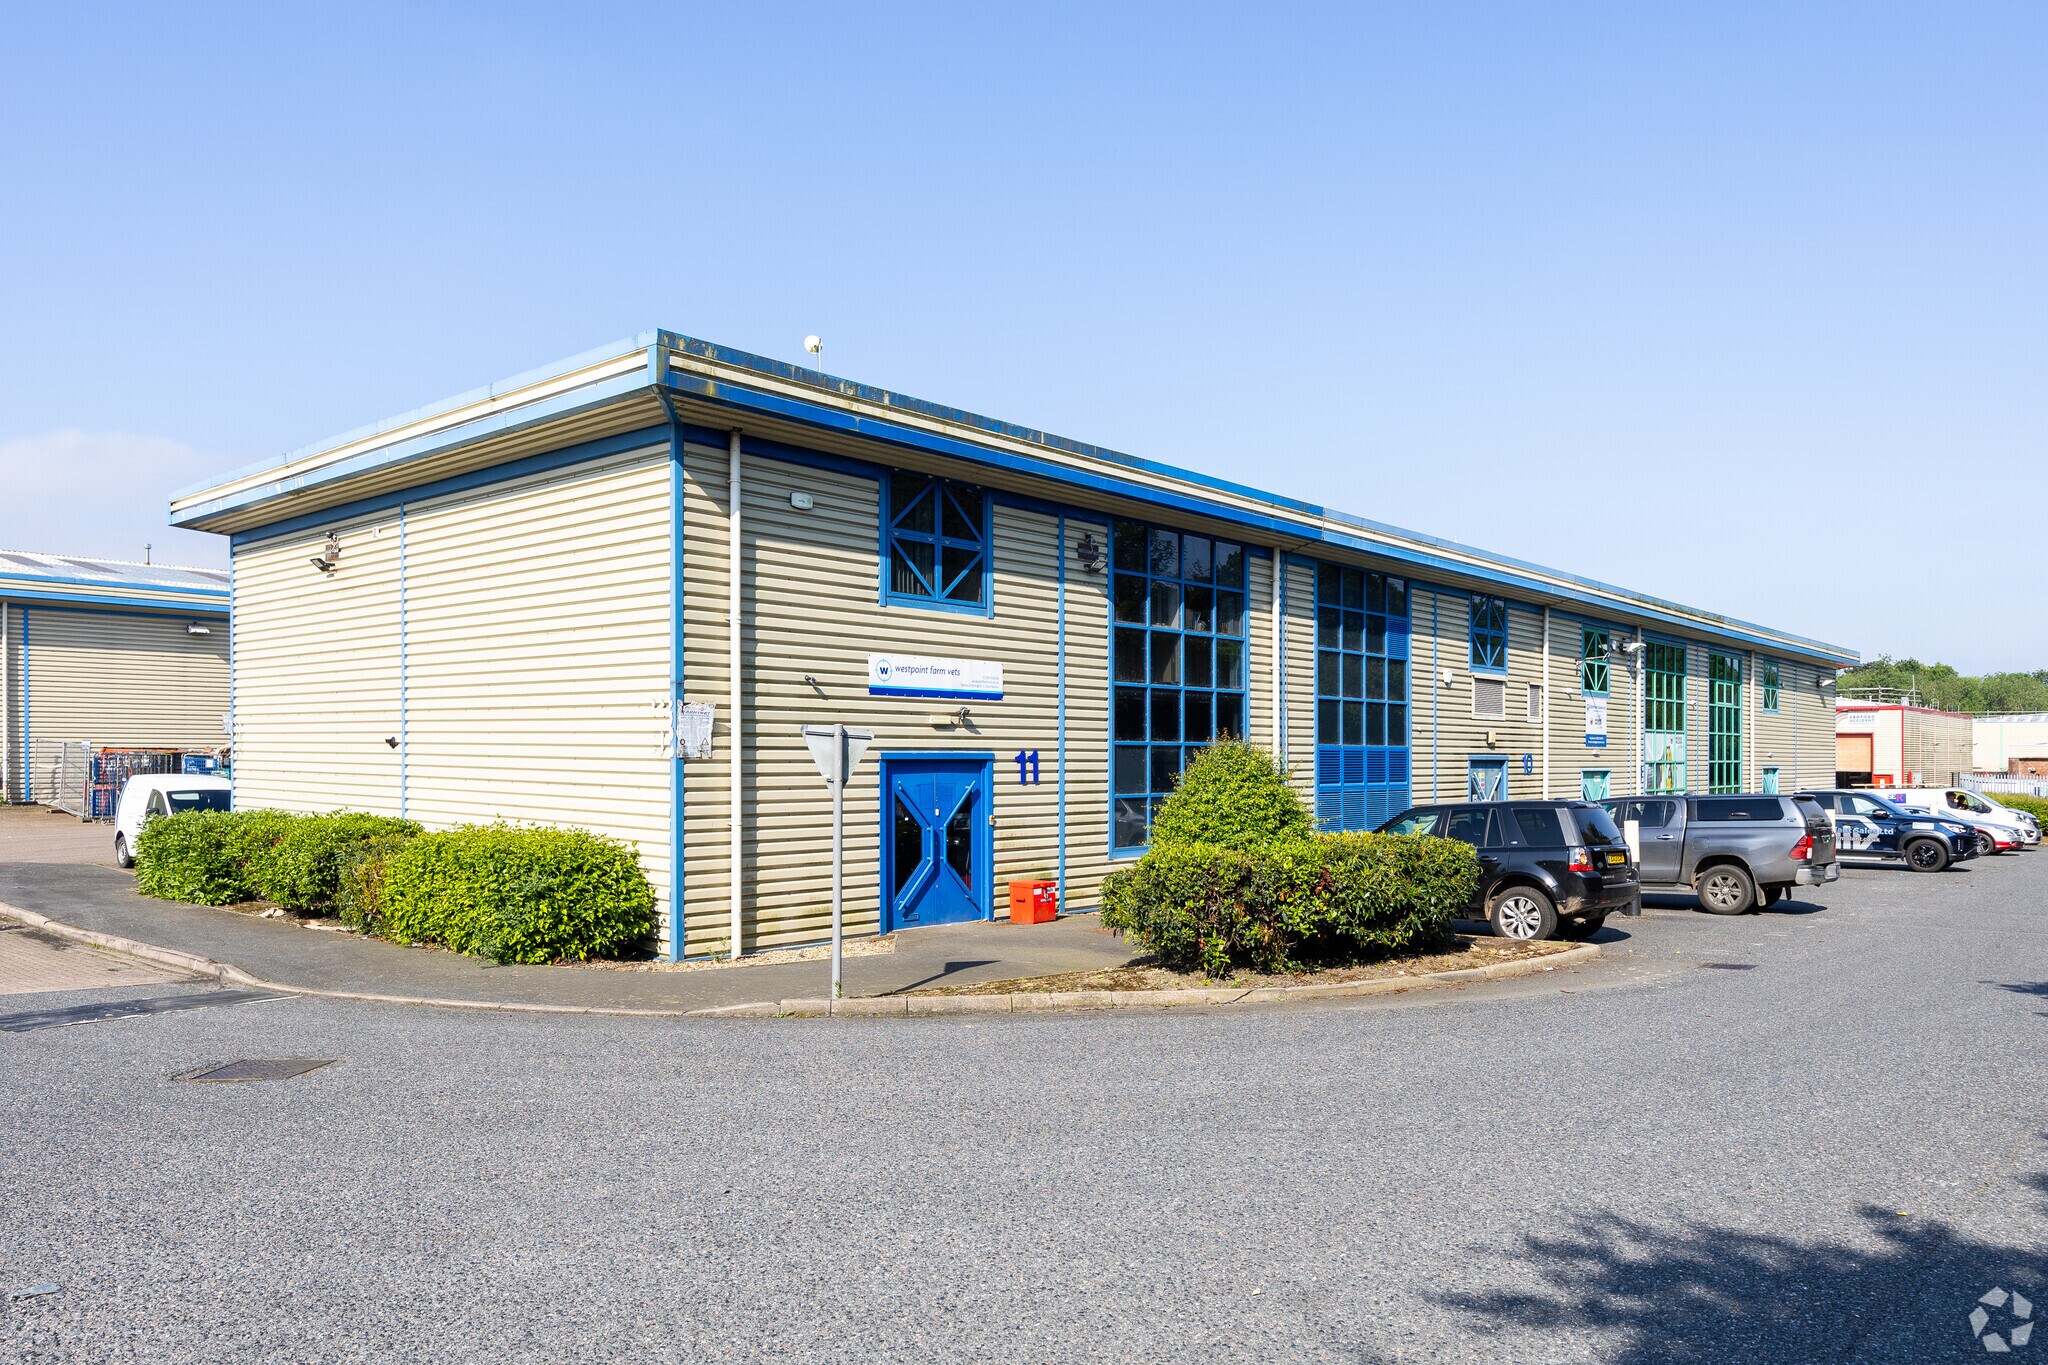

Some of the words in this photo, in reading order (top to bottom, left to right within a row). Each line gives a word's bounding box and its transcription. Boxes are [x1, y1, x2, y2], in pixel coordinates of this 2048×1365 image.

[895, 665, 929, 675] westpoint
[930, 665, 946, 675] farm
[947, 668, 961, 676] vets
[1014, 750, 1039, 785] 11
[1522, 753, 1533, 775] 10
[1853, 827, 1879, 835] Sales
